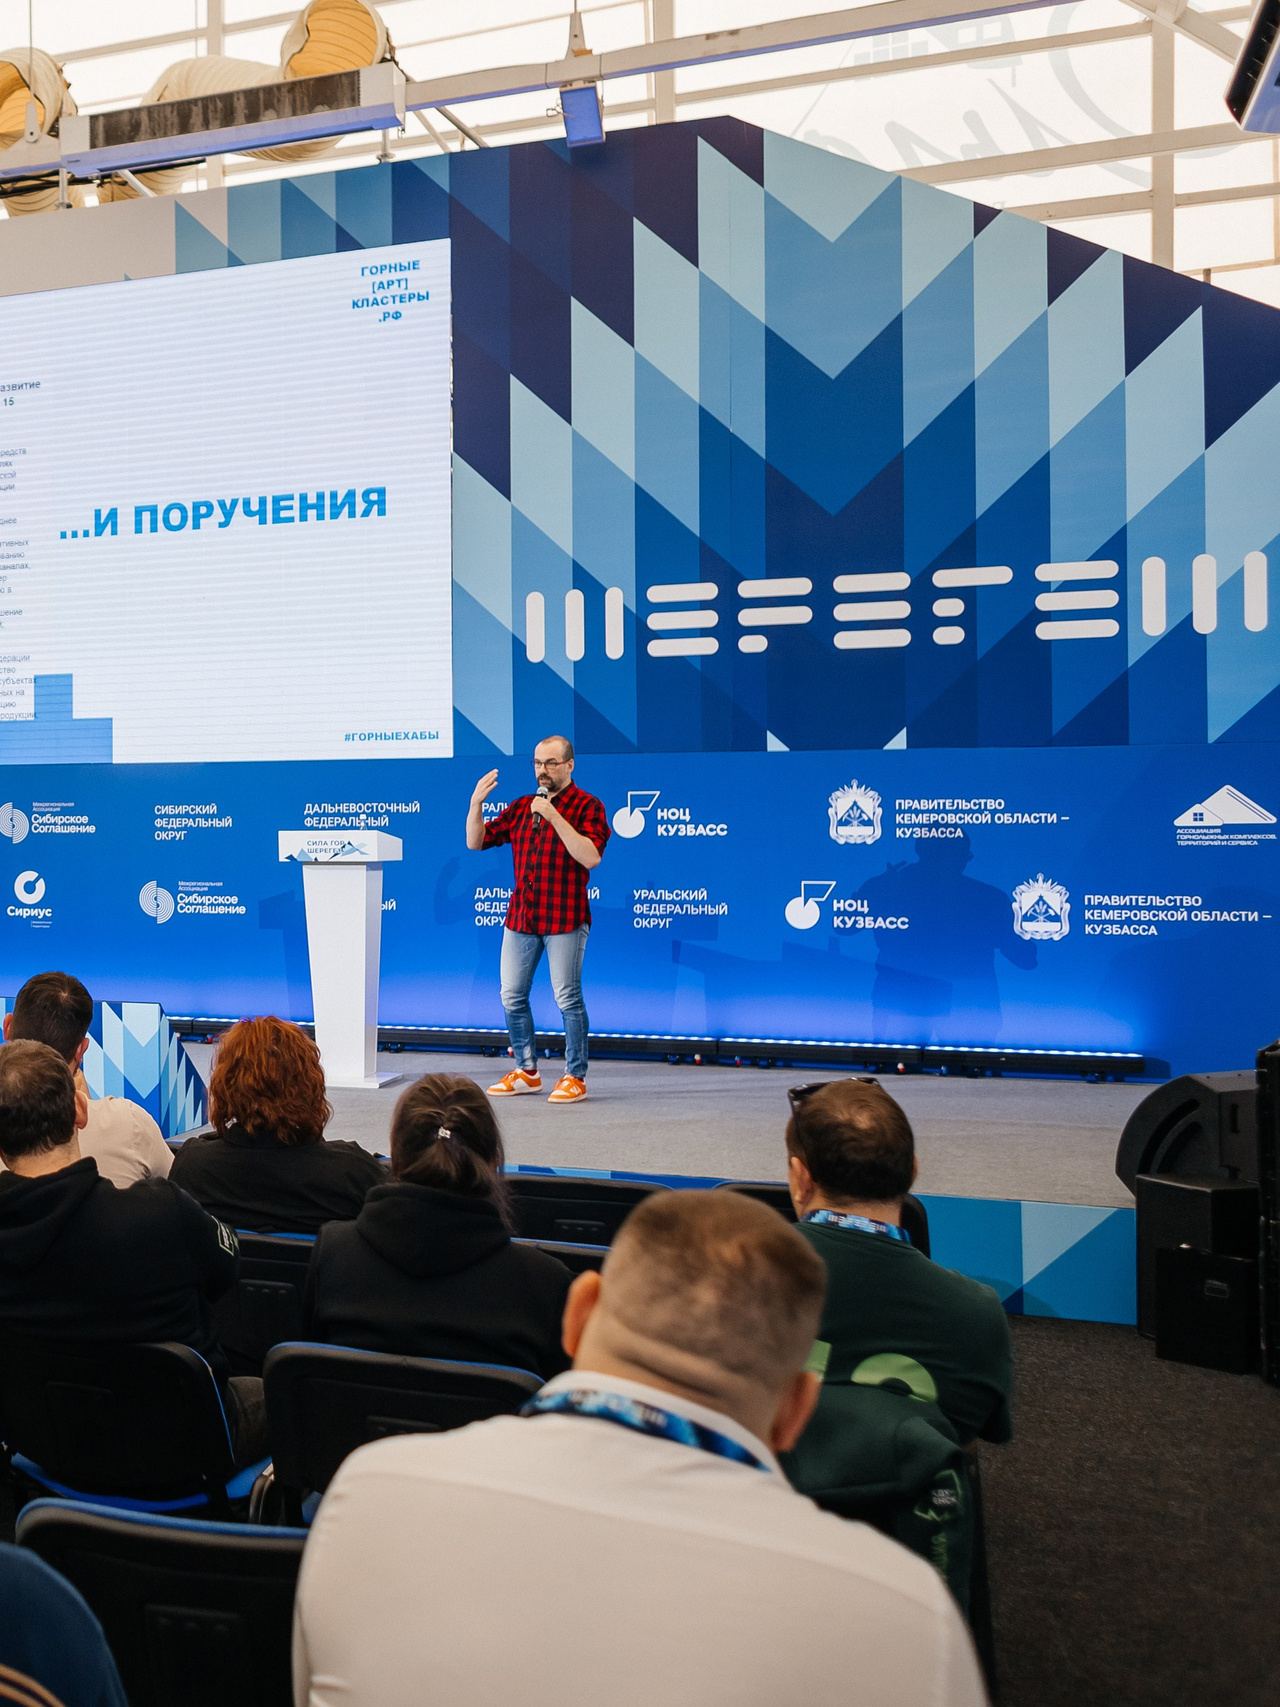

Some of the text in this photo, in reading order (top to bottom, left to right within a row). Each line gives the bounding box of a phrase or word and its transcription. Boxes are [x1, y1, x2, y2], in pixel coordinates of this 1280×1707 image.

[361, 260, 420, 276] ГОРНЫЕ
[372, 278, 408, 293] [АРТ]
[352, 291, 429, 310] КЛАСТЕРЫ
[378, 310, 402, 322] .РФ
[3, 397, 14, 406] 15
[134, 486, 387, 534] ПОРУЧЕНИЯ
[344, 731, 439, 741] #ГОРНЫЕХАБЫ
[154, 803, 217, 815] СИБИРСКИЙ
[304, 801, 420, 815] ДАЛЬНЕВОСТОЧНЫЙ
[895, 798, 1005, 811] ПРАВИТЕЛЬСТВО
[31, 814, 88, 825] Сибирское
[657, 808, 691, 822] НОЦ
[895, 811, 990, 825] КЕМЕРОВСКОЙ
[994, 813, 1057, 824] ОБЛАСТИ
[31, 824, 96, 834] Соглашение
[154, 817, 232, 829] ФЕДЕРАЛЬНЫЙ
[154, 831, 187, 841] ОКРУГ
[657, 824, 728, 837] КУЗБАСС
[895, 826, 963, 839] КУЗБАССА
[177, 893, 238, 905] Сибирское
[633, 888, 707, 901] УРАЛЬСКИЙ
[1084, 894, 1202, 907] ПРАВИТЕЛЬСТВО
[6, 906, 52, 919] Сириус
[177, 903, 246, 915] Соглашение
[633, 902, 728, 917] ФЕДЕРАЛЬНЫЙ
[832, 899, 869, 914] НОЦ
[1084, 908, 1187, 922] КЕМЕРОВСКОЙ
[1191, 910, 1258, 922] ОБЛАСТИ
[633, 918, 673, 929] ОКРУГ
[832, 916, 909, 930] КУЗБАСС
[1084, 923, 1158, 936] КУЗБАССА
